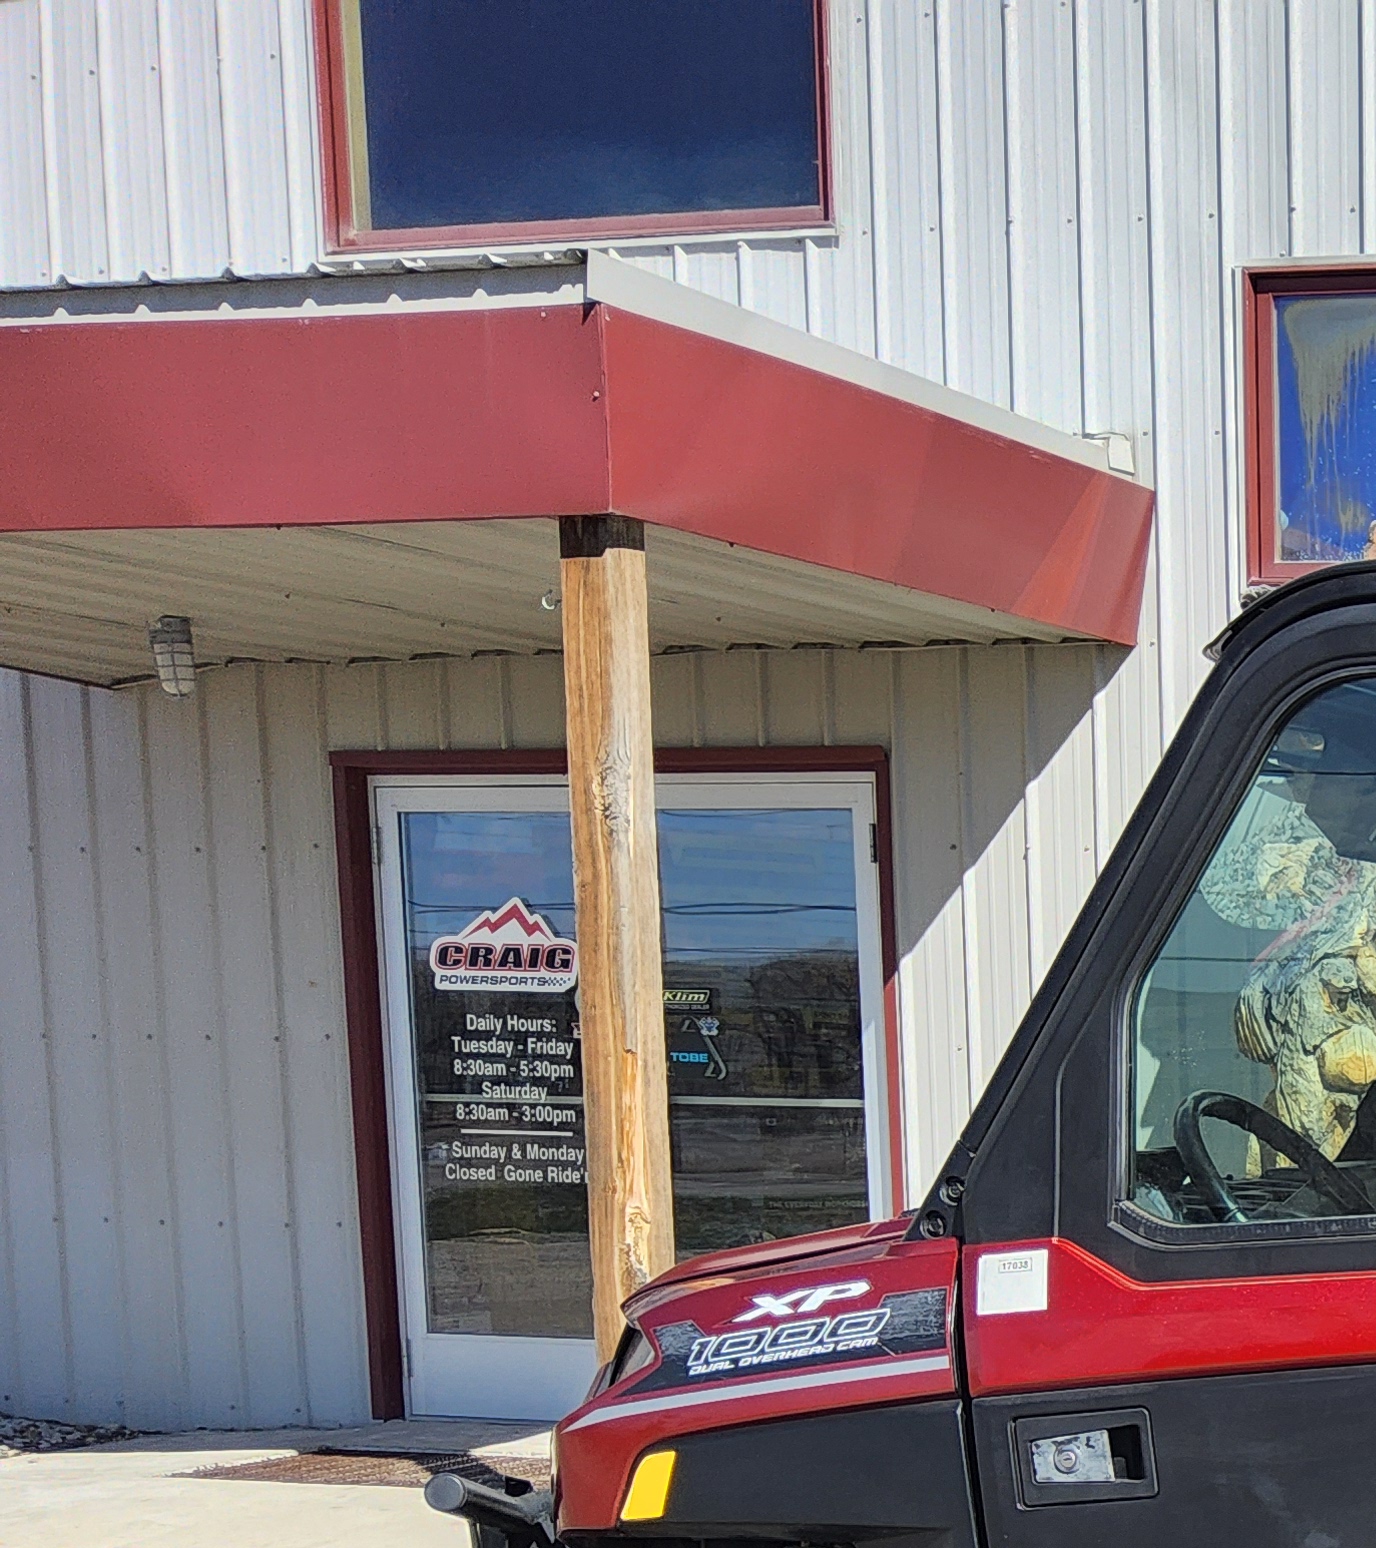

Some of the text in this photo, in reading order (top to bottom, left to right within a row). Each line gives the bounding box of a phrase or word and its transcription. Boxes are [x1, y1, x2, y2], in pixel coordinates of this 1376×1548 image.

[434, 941, 576, 974] CRAIG
[438, 974, 547, 987] POWERSPORTS
[465, 1013, 557, 1035] Daily Hours:
[450, 1036, 514, 1058] Tuesday
[527, 1037, 574, 1059] Friday
[670, 1051, 709, 1063] TOBE
[453, 1058, 507, 1076] 8:30am
[519, 1060, 575, 1082] 5:30pm
[481, 1081, 548, 1103] Saturday
[456, 1103, 509, 1121] 8:30am
[521, 1105, 576, 1126] 3:00pm
[451, 1141, 585, 1165] Sunday & Monday
[445, 1162, 496, 1181] Closed
[503, 1164, 544, 1182] Gone
[728, 1278, 873, 1323] XP
[687, 1308, 892, 1367] 1000
[688, 1335, 879, 1377] DUAL OVERHEAD CAM
